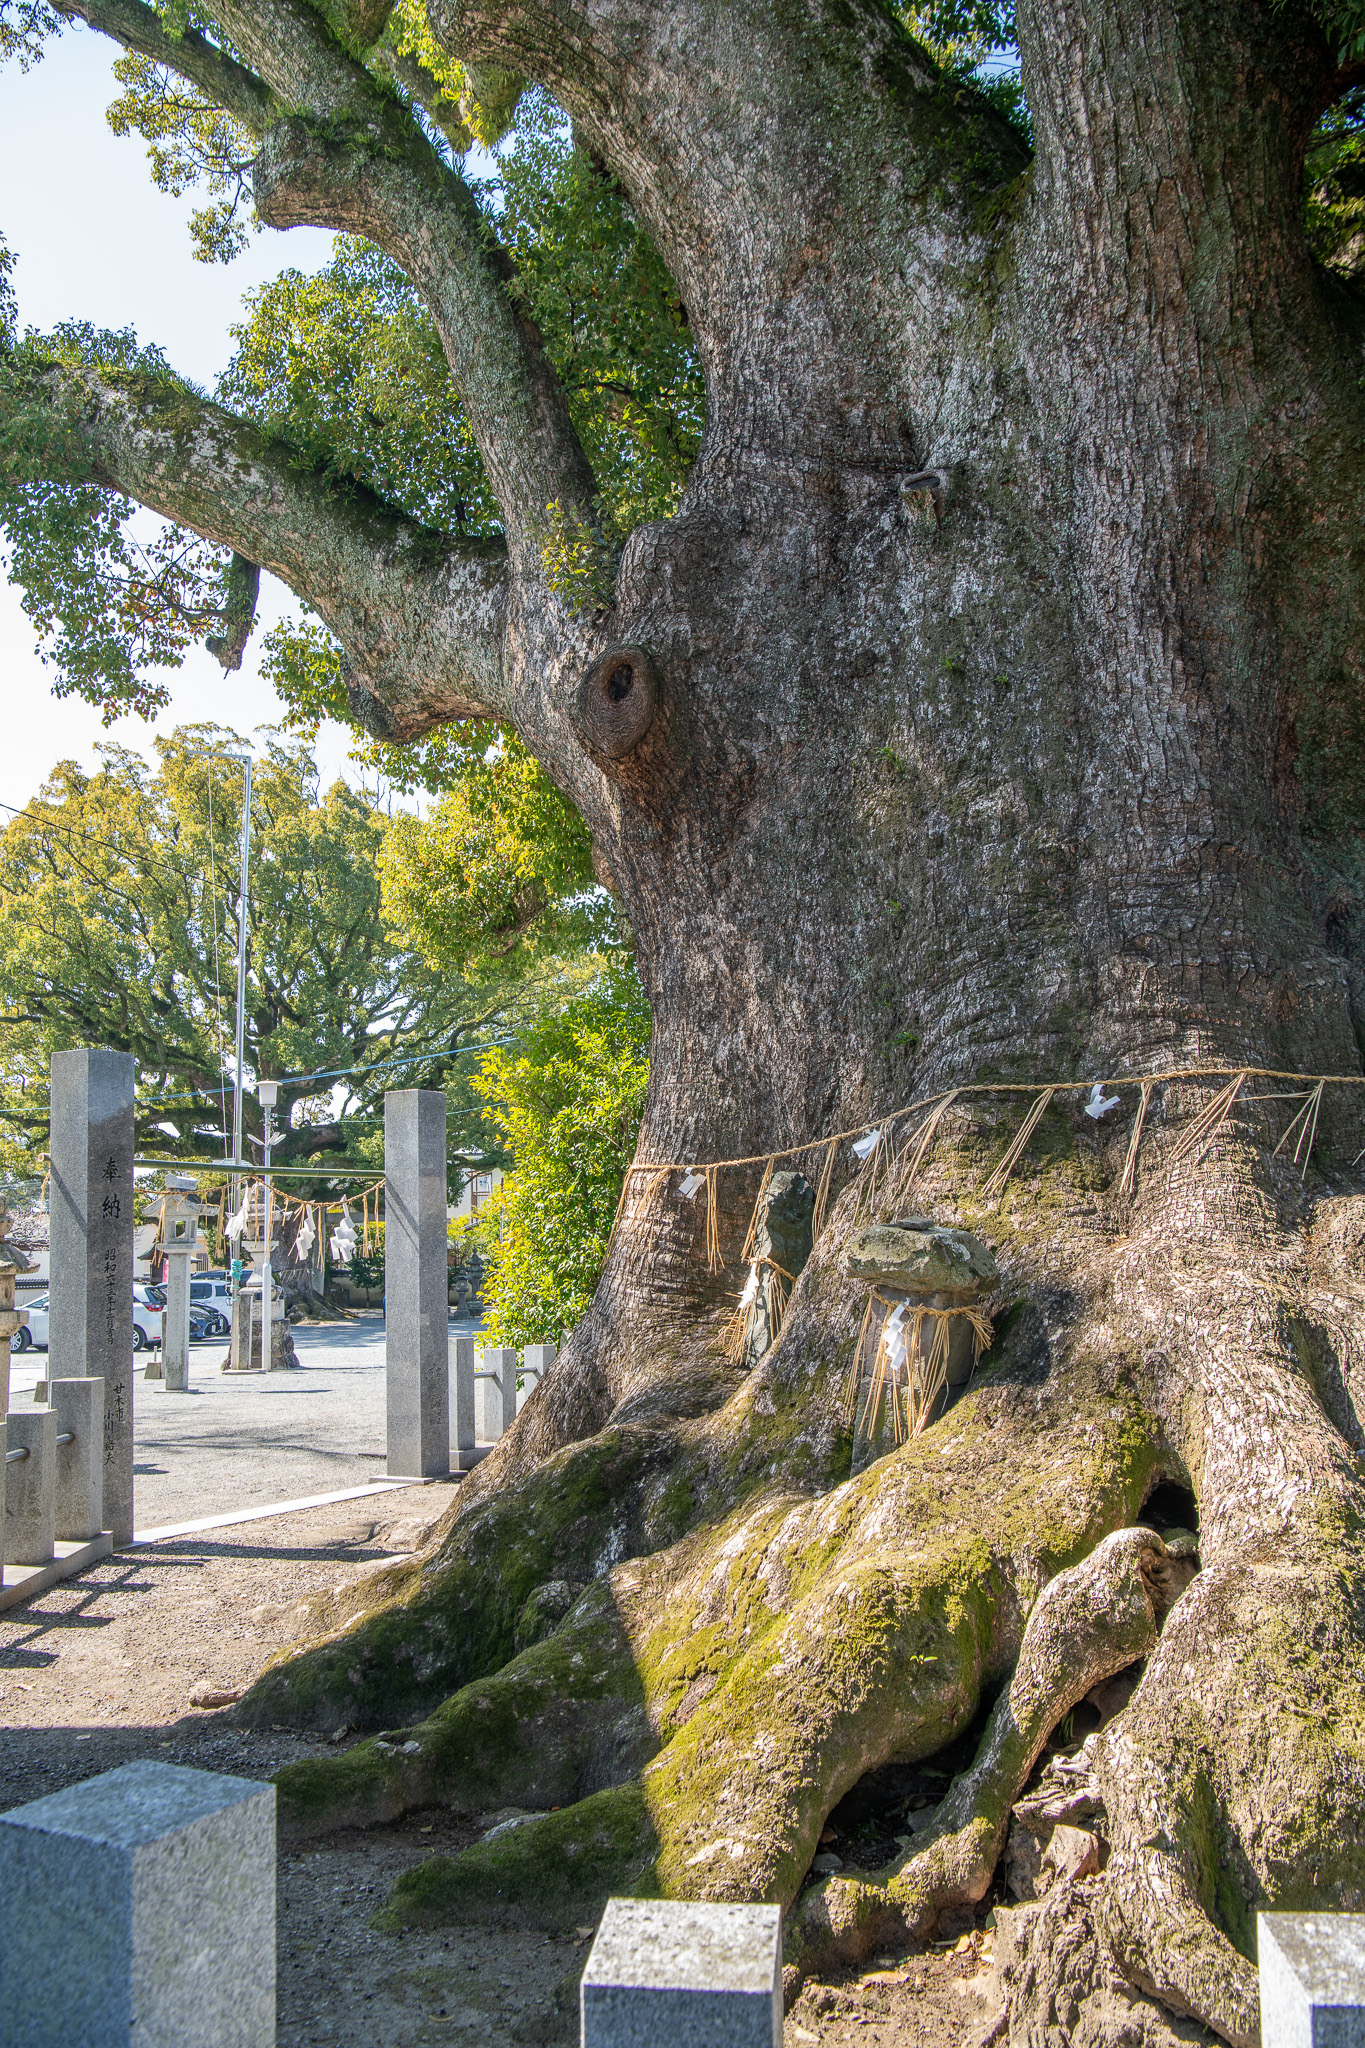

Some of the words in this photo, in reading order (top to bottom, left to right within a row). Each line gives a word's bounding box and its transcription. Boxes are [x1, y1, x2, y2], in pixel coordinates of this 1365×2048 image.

[101, 1156, 122, 1220] 奉納
[113, 1382, 125, 1422] 甘木市
